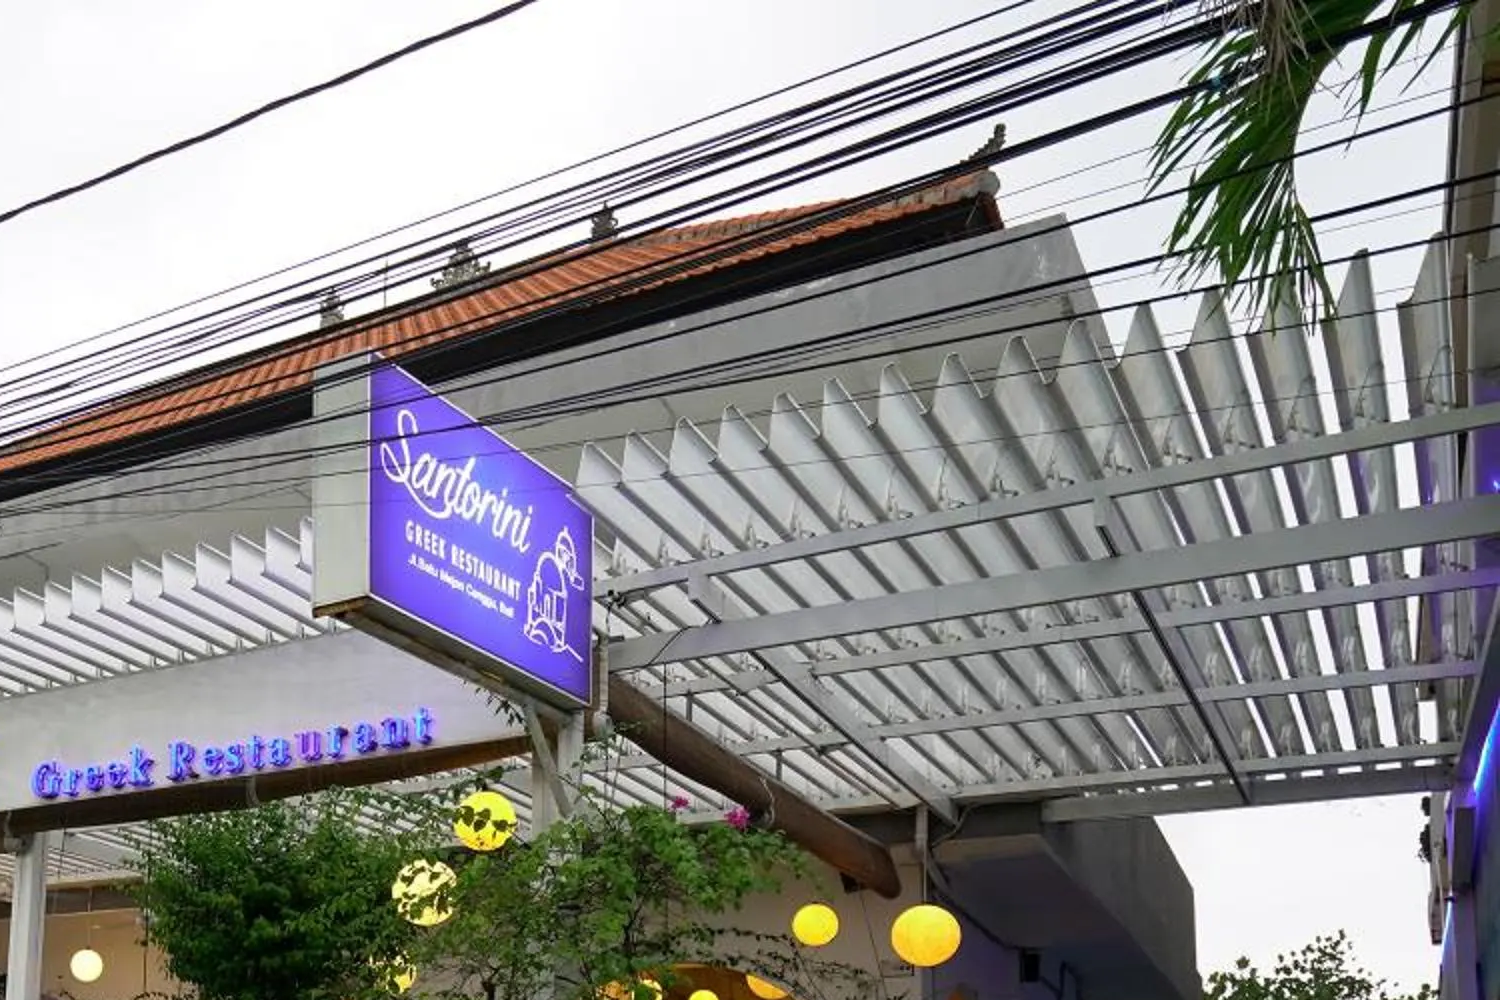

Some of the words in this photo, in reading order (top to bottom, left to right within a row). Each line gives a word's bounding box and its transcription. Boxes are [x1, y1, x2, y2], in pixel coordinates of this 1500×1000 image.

[380, 409, 533, 553] Santorini
[405, 520, 446, 560] GREEK
[451, 543, 521, 601] RESTAURANT
[30, 743, 156, 800] Greek
[166, 706, 435, 781] Restaurant
